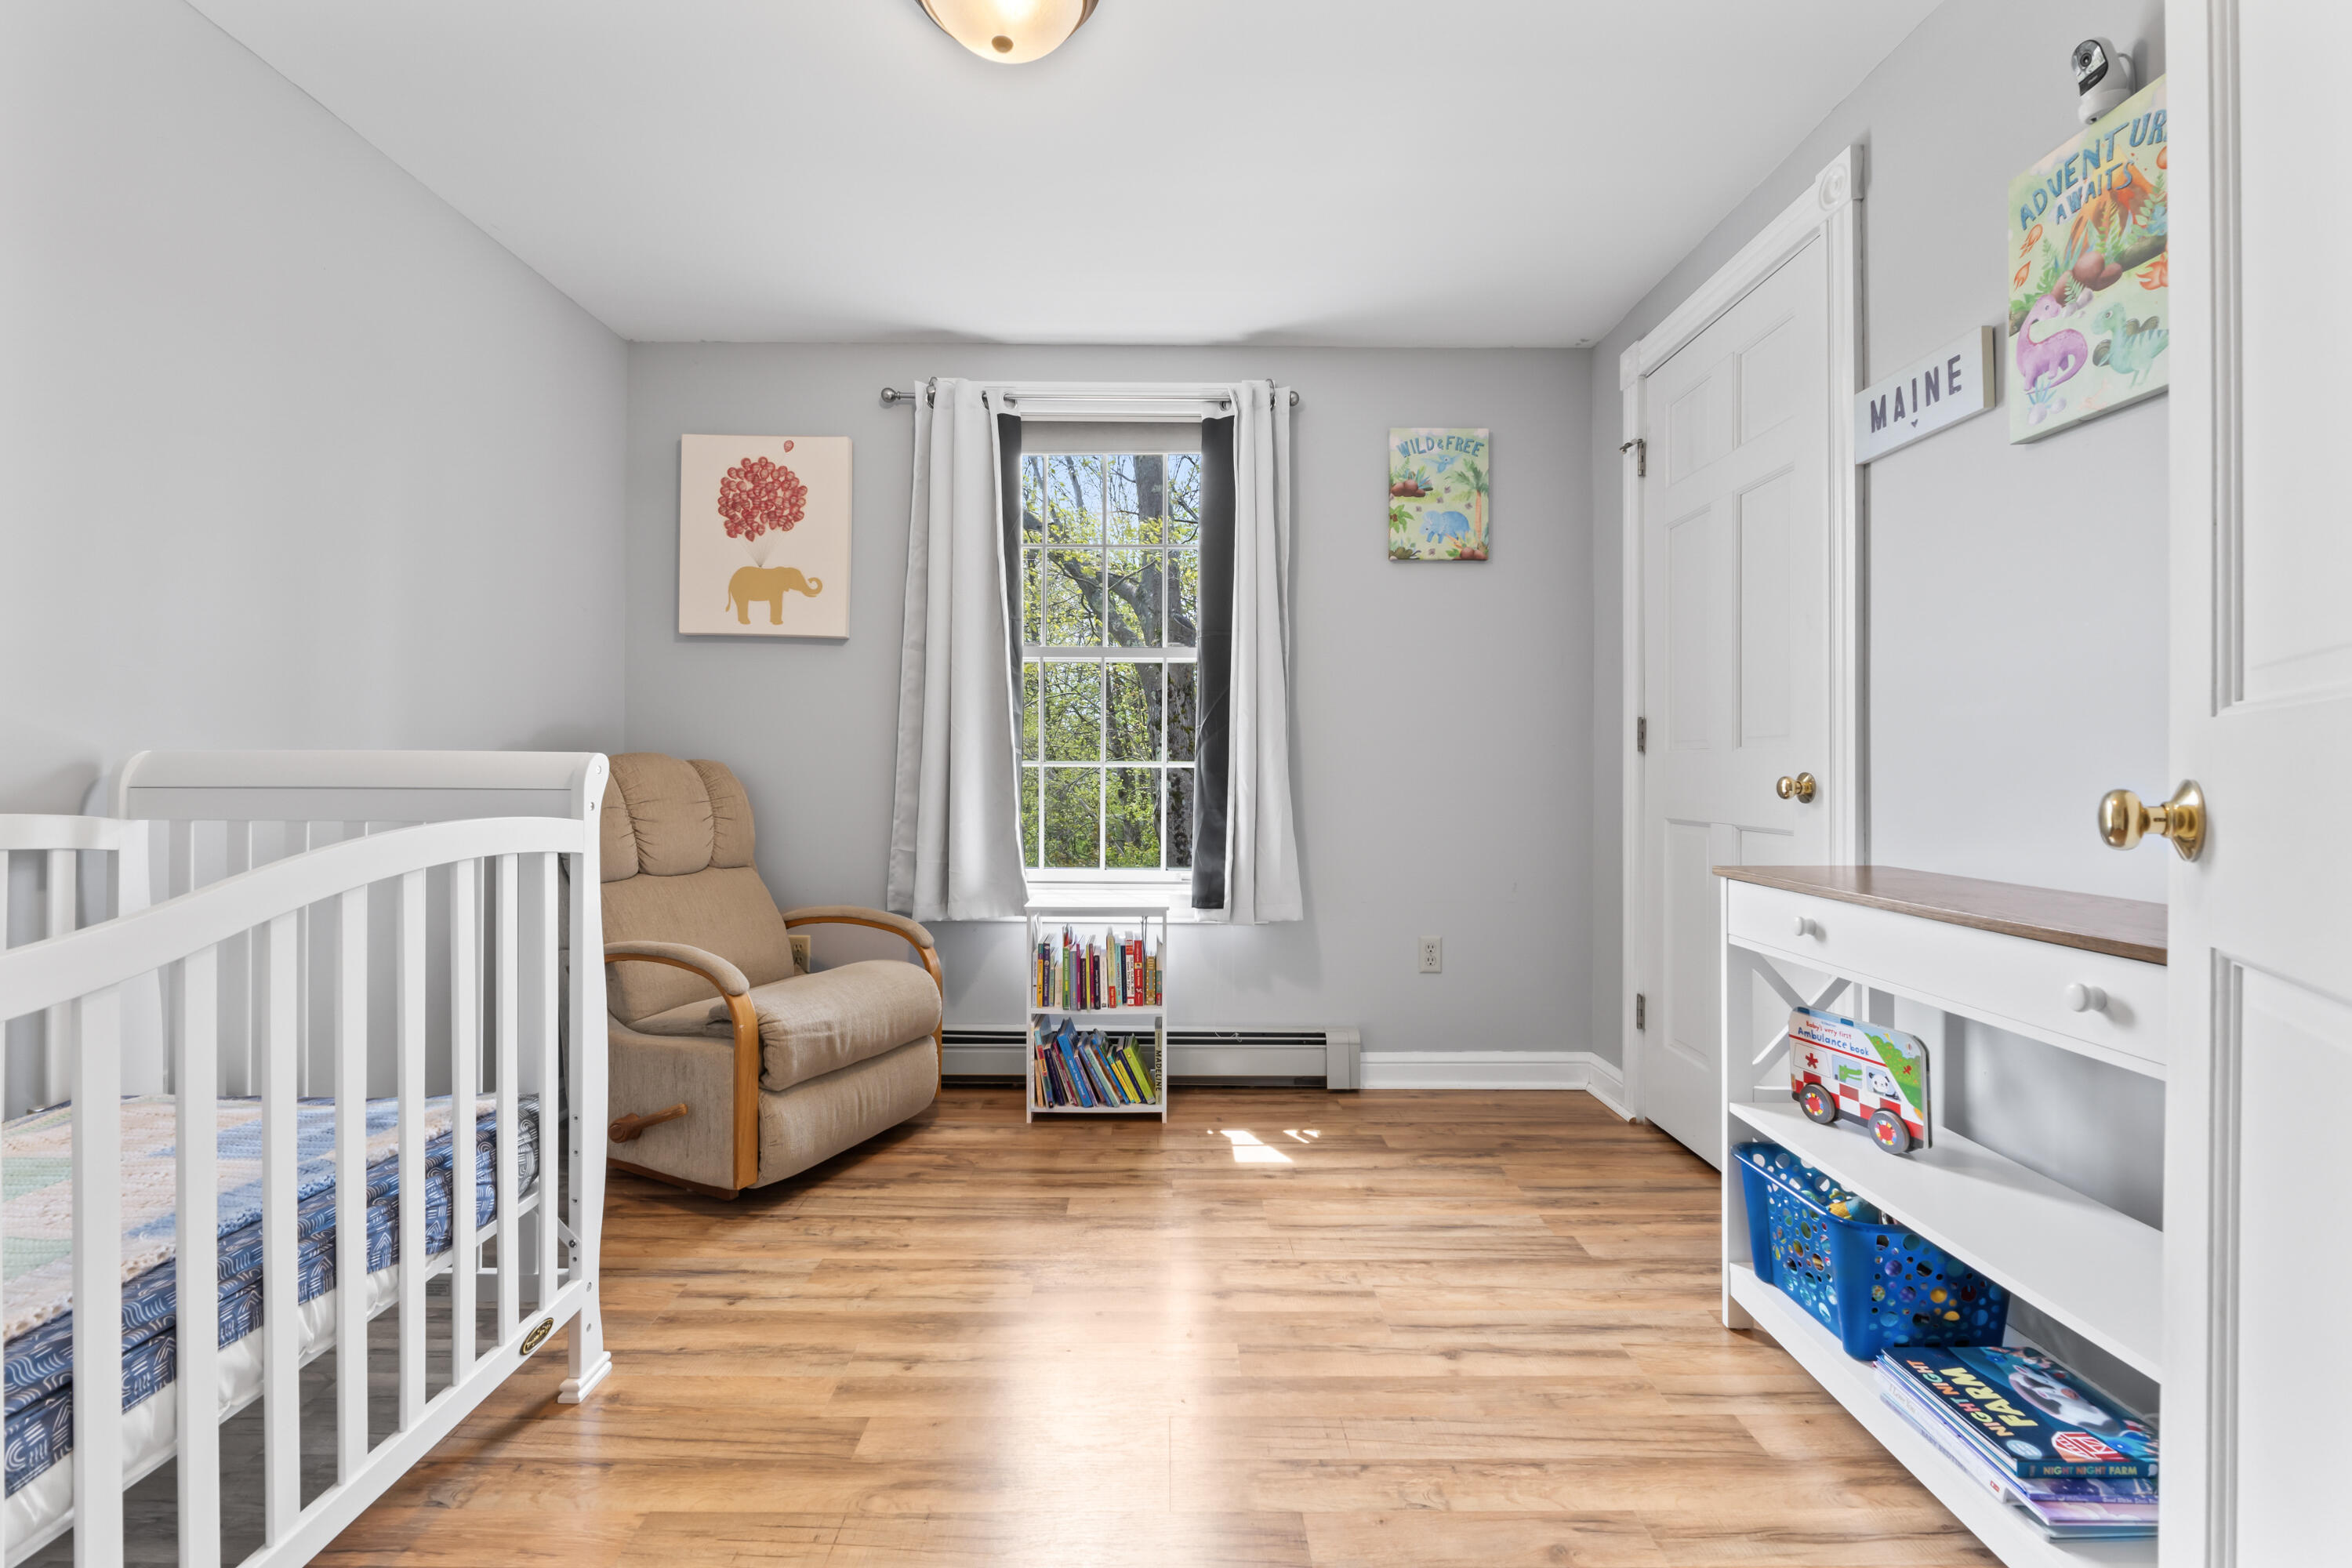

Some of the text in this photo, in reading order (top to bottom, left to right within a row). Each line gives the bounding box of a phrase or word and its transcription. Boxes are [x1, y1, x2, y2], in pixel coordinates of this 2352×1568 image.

[2020, 109, 2167, 230] ADVENTUR
[2056, 159, 2134, 225] AWAITS
[1870, 354, 1962, 433] MAINE
[1396, 435, 1485, 458] WILD & FREE
[1798, 1026, 1869, 1055] Ambulance book
[1806, 1020, 1823, 1032] Baby's
[1824, 1028, 1837, 1036] very
[1906, 1359, 2015, 1437] NIGHT NIGHT
[1940, 1367, 2038, 1426] FARM
[2043, 1466, 2074, 1475] NIGHT
[2076, 1466, 2107, 1475] NIGHT
[2109, 1466, 2138, 1475] FARM
